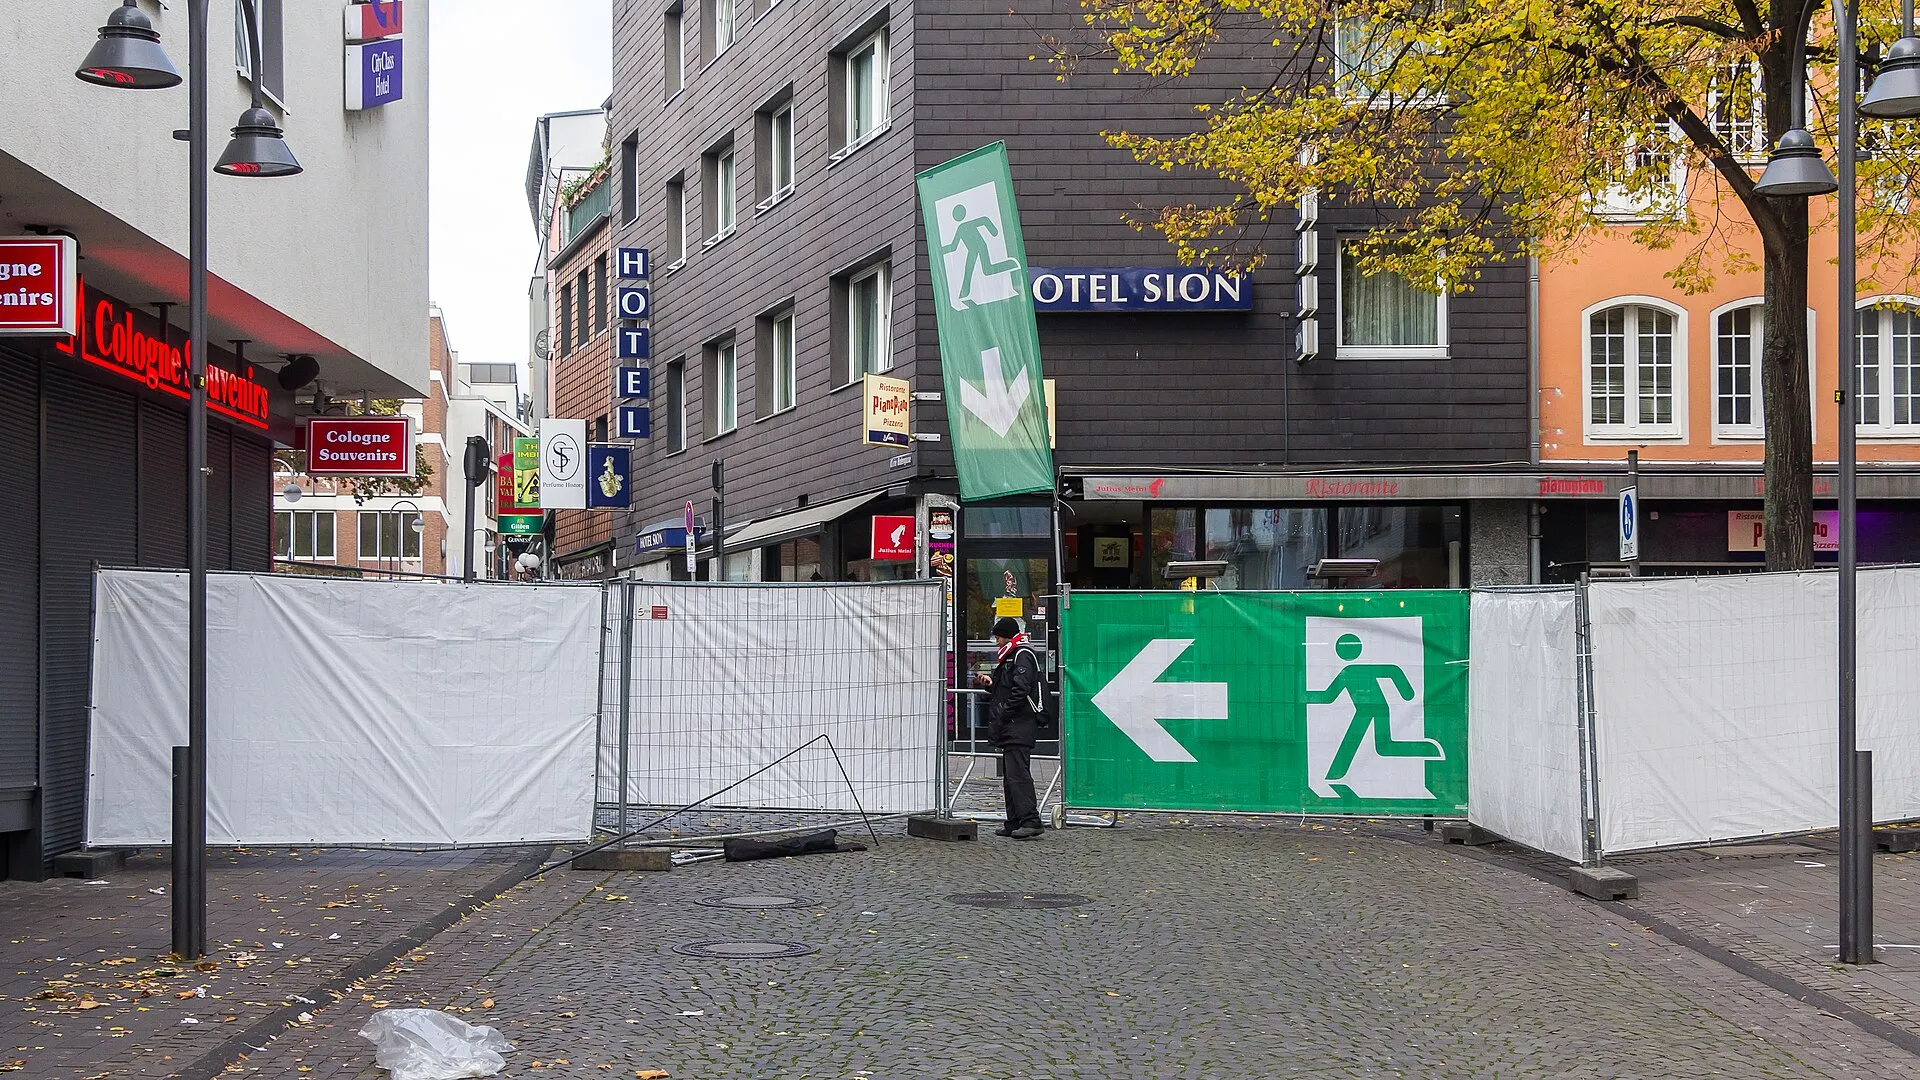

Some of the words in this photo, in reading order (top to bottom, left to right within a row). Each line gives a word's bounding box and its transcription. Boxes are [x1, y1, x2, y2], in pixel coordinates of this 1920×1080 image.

[371, 51, 395, 77] CityClass
[375, 74, 390, 97] Hotel
[1143, 273, 1240, 303] SION
[95, 299, 182, 390] Cologne
[622, 251, 646, 434] HOTEL
[879, 382, 906, 394] Ristorante
[326, 430, 391, 445] Cologne
[319, 448, 397, 461] Souvenirs
[565, 482, 584, 490] History
[1305, 478, 1399, 498] Ristorante
